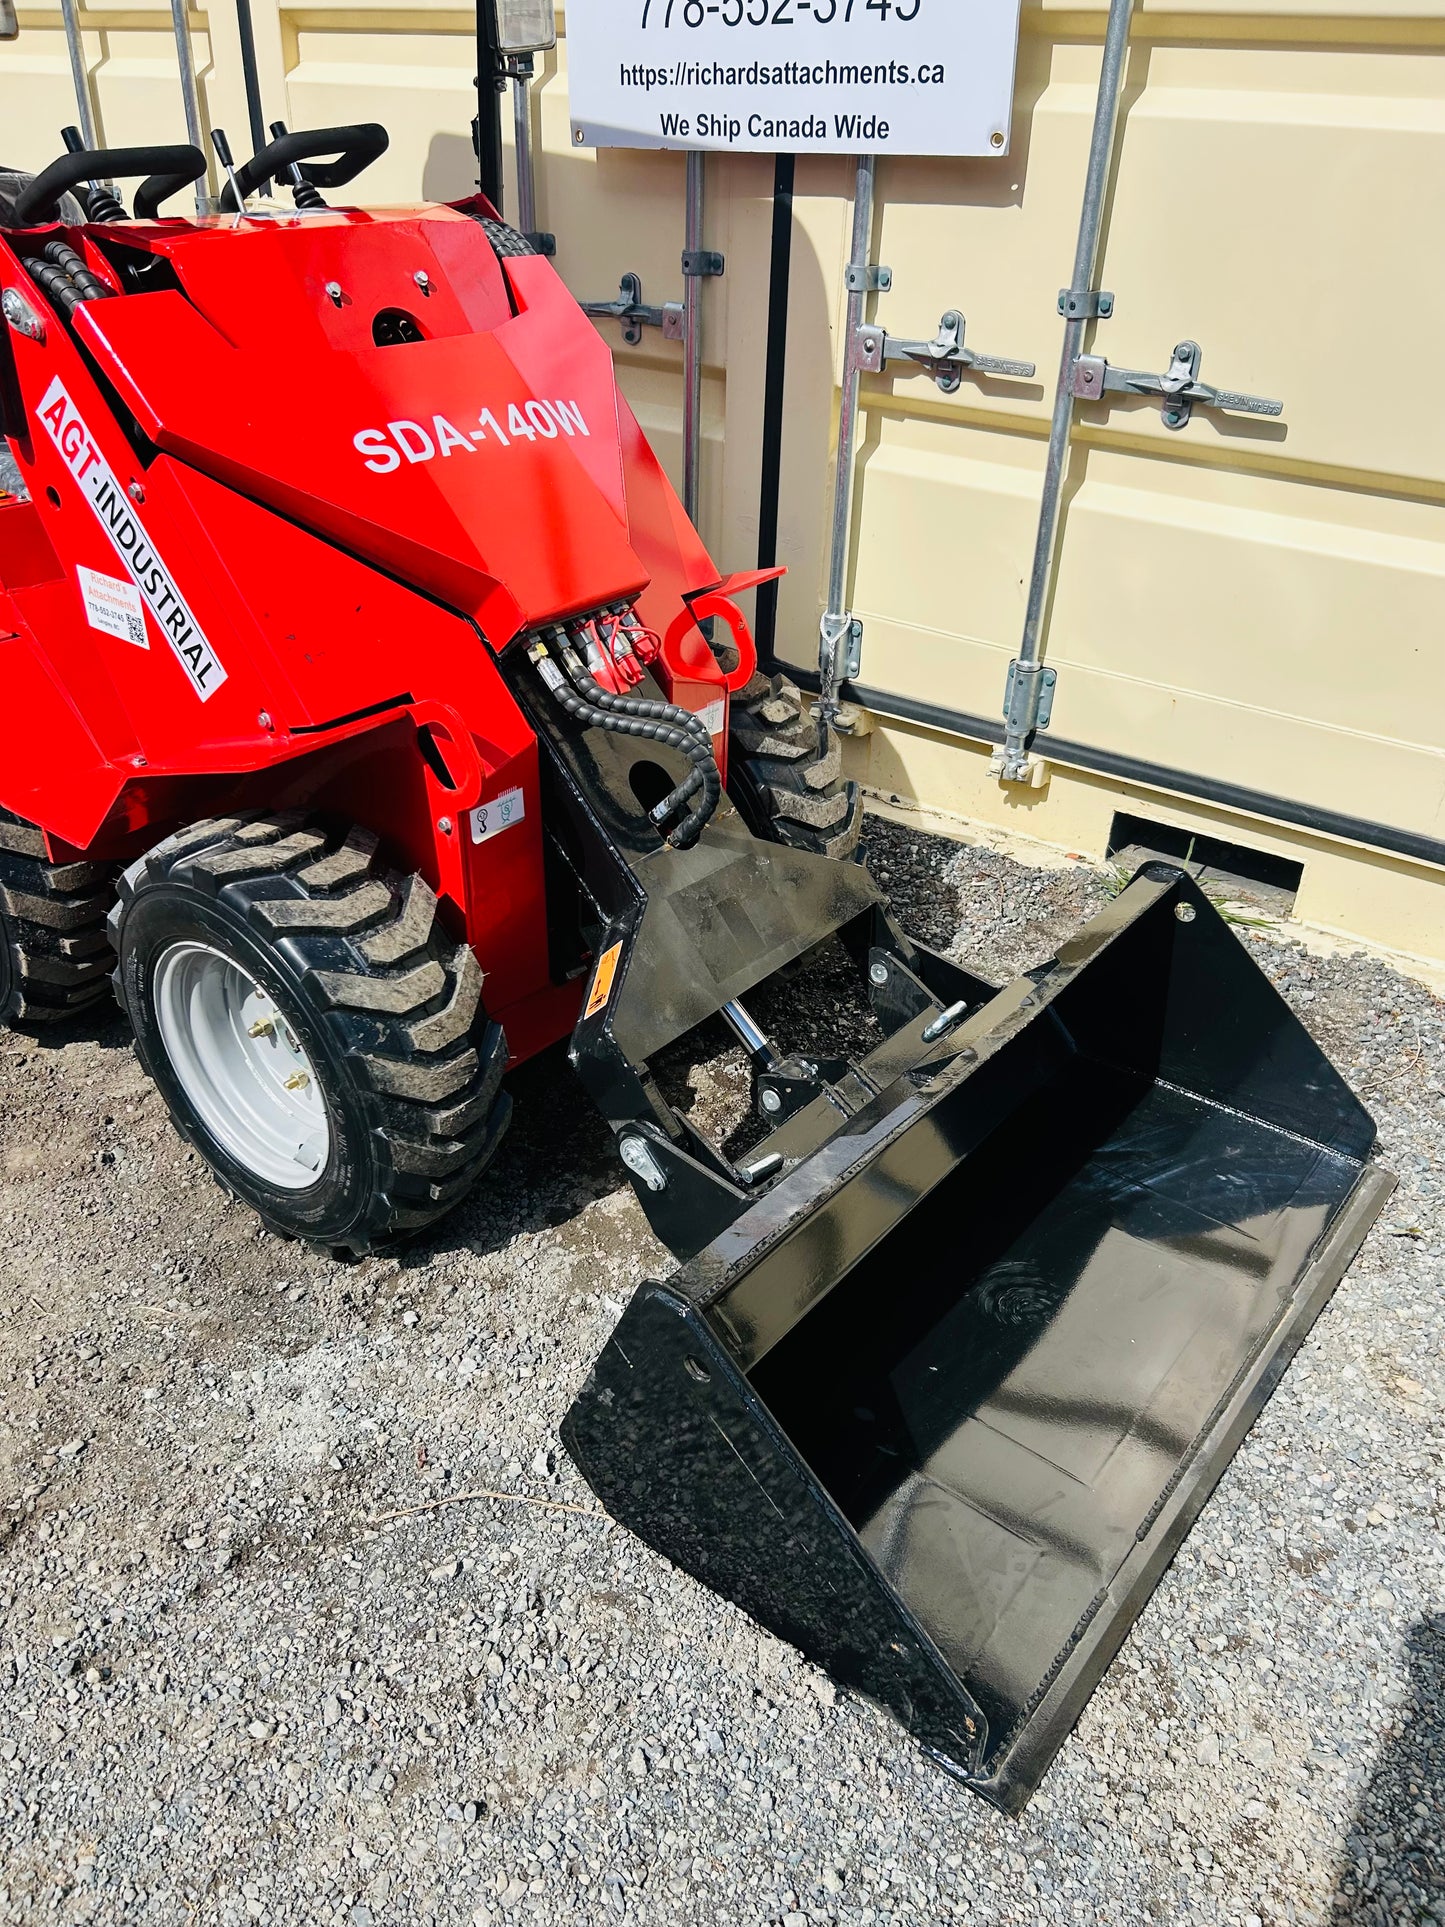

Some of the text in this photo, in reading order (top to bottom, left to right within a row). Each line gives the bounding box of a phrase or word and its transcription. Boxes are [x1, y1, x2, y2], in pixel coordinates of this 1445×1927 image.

[619, 60, 945, 91] https://richardsattachments.ca
[660, 113, 890, 142] We Ship Canada Wide
[352, 399, 591, 474] SDA-140W
[90, 572, 128, 595] Richard's
[88, 585, 137, 613] Attachments
[88, 601, 125, 622] 778-552-3745
